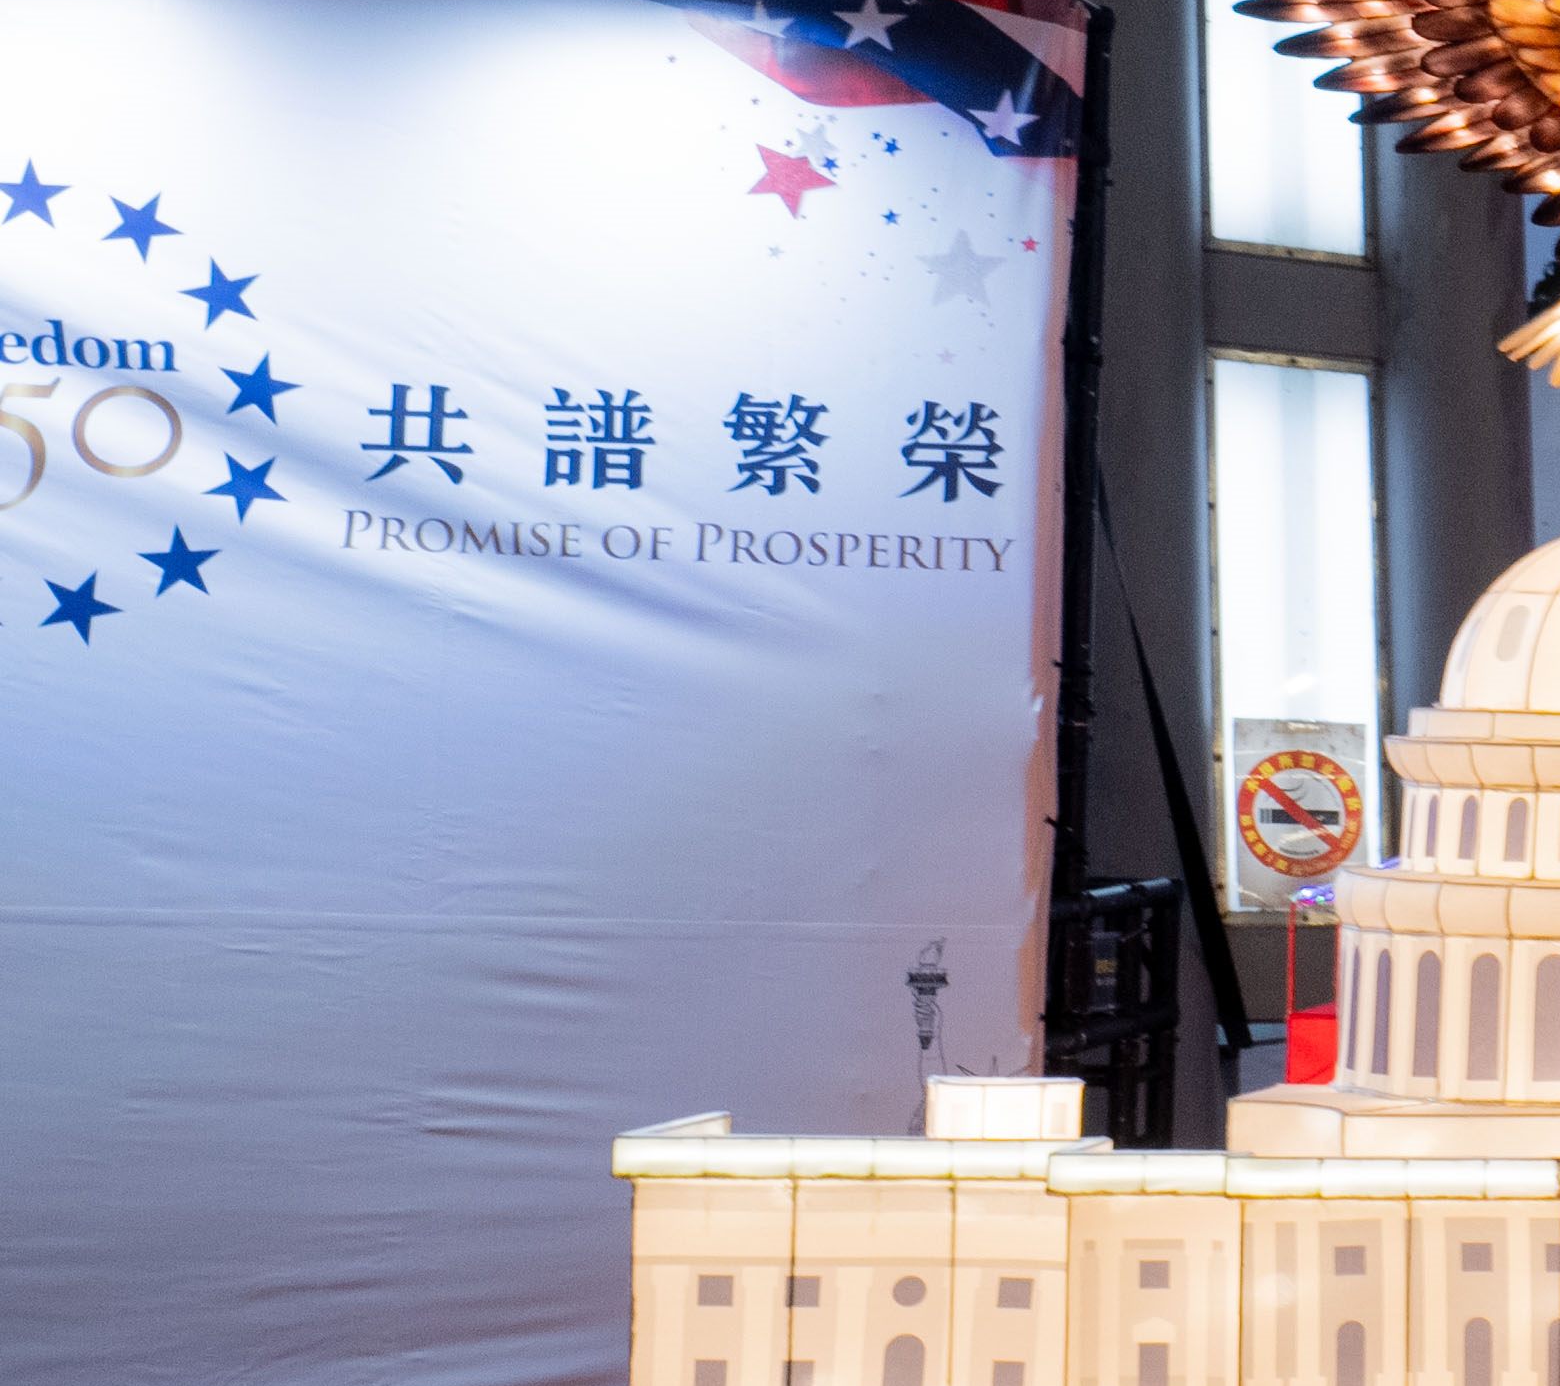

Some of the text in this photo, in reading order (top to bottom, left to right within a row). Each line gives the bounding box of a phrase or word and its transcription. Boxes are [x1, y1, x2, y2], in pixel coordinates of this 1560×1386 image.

[360, 382, 1006, 503] 共譜繁榮
[601, 523, 674, 562] OF
